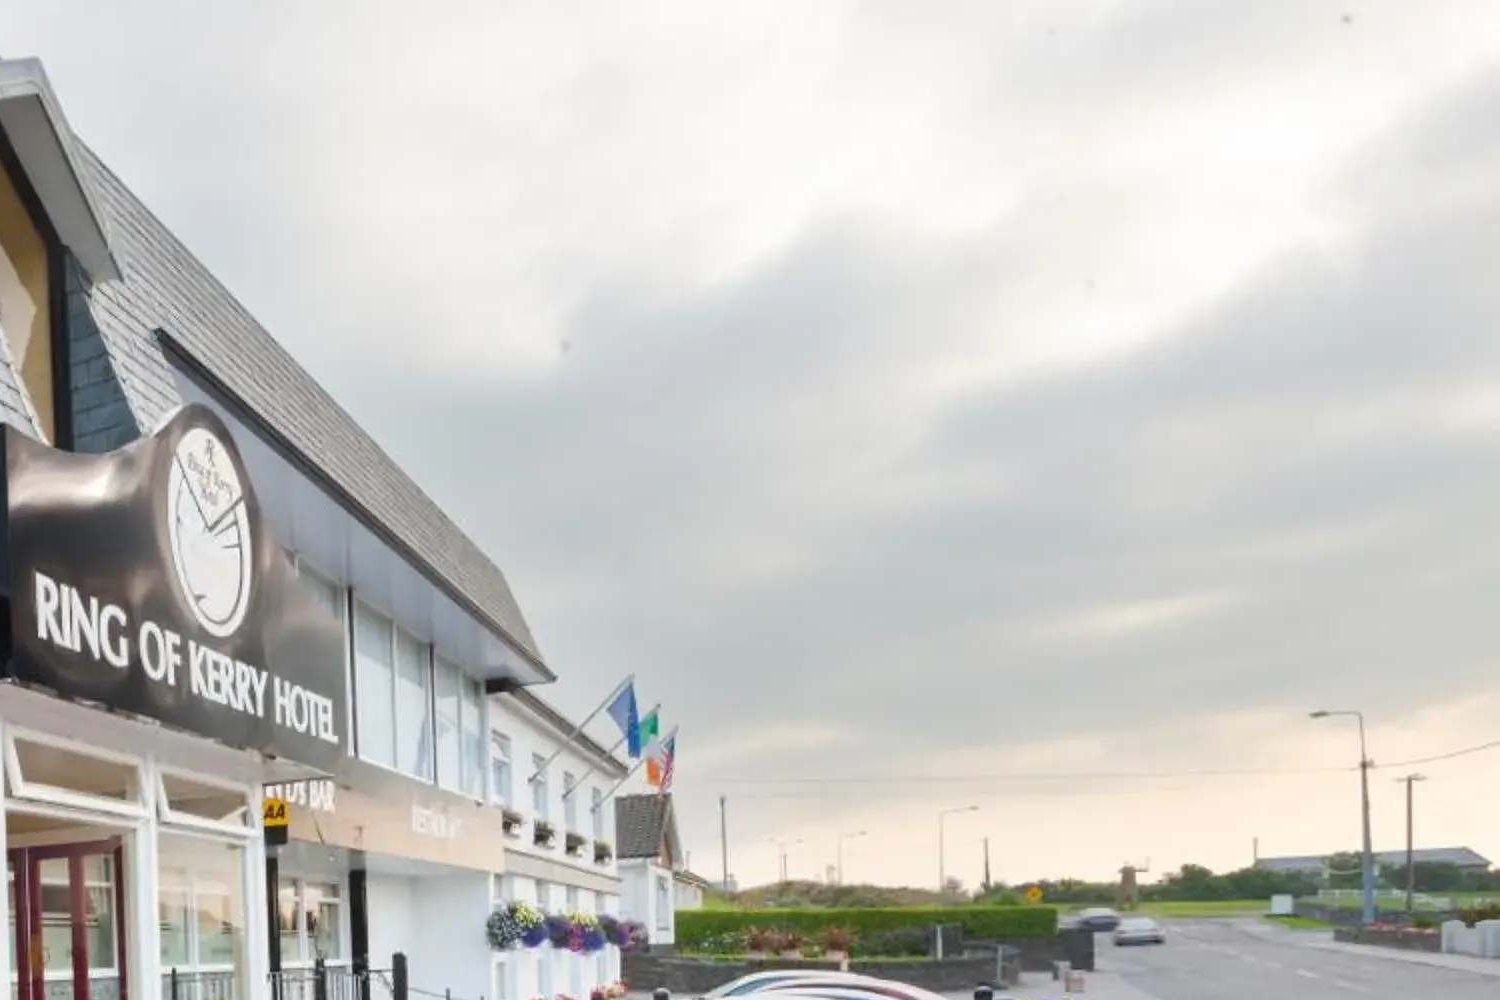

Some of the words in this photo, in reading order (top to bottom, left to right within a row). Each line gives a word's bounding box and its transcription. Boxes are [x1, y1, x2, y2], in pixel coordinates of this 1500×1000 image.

[34, 570, 129, 667] RING
[138, 620, 181, 686] OF
[188, 639, 269, 718] KERRY
[273, 675, 339, 744] HOTEL
[263, 803, 286, 819] AA
